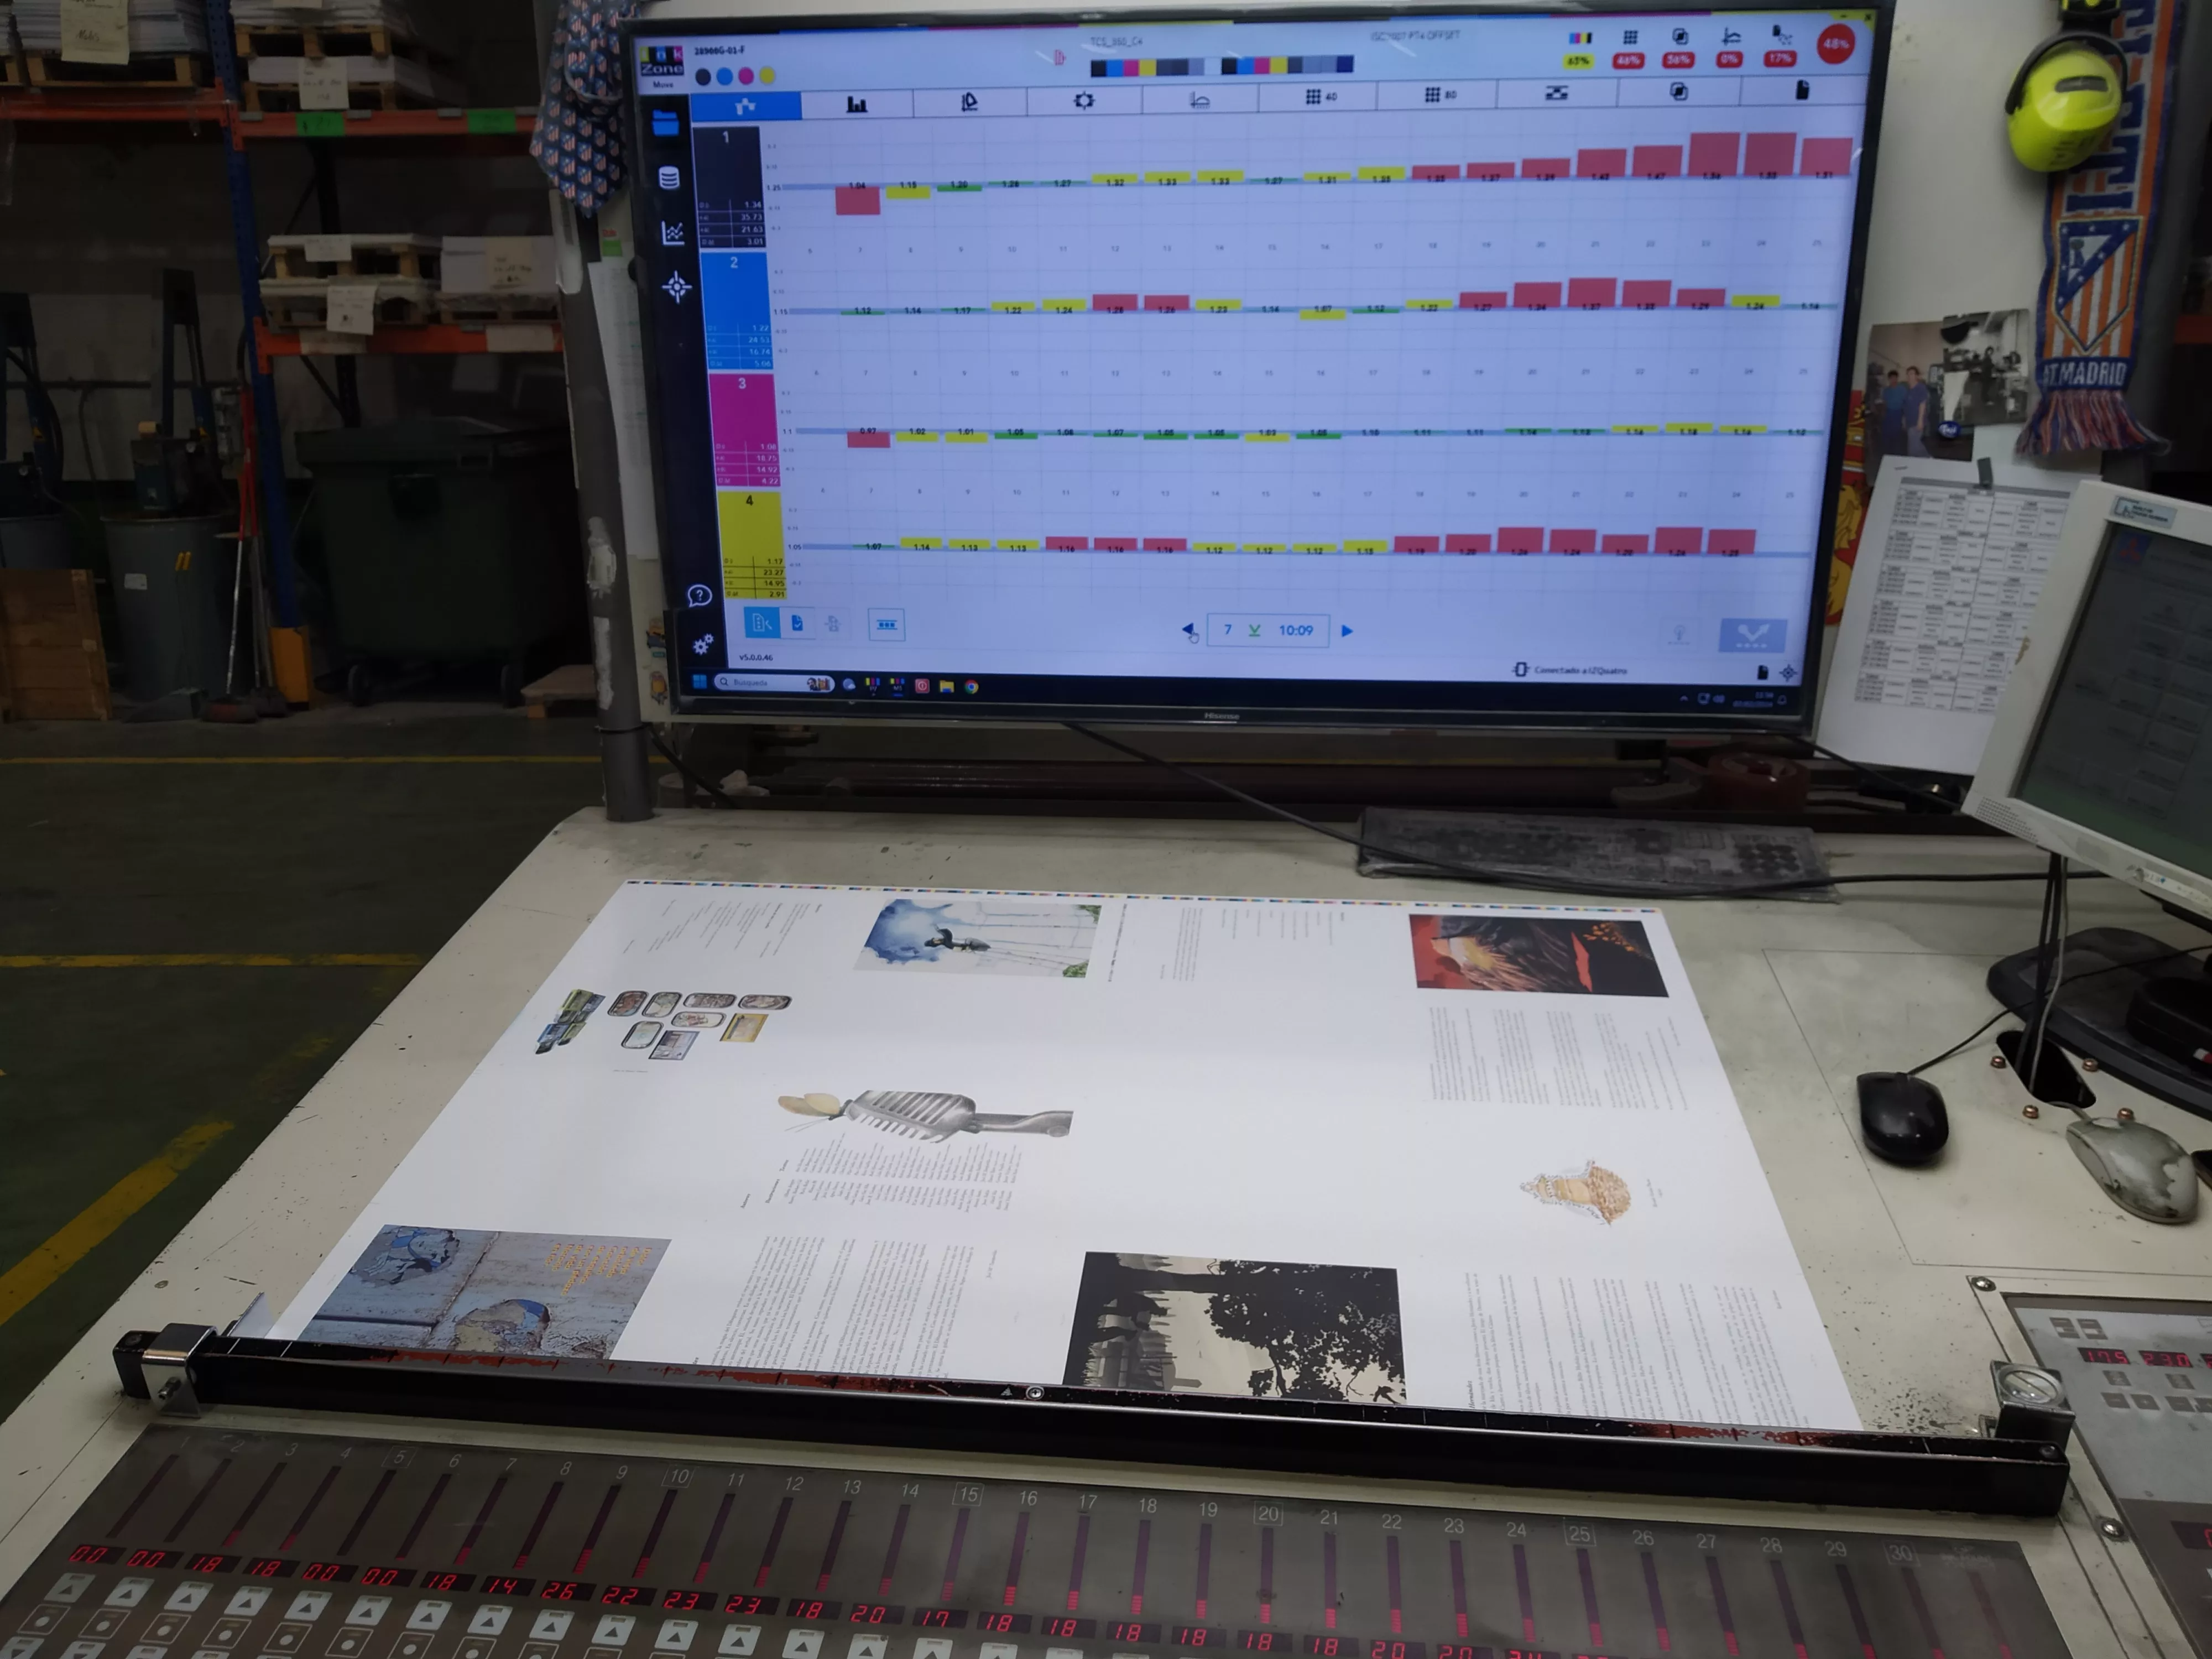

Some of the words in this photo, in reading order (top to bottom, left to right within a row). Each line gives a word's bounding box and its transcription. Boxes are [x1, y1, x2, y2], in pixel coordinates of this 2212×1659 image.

[641, 64, 684, 74] Zone
[723, 131, 729, 143] 1
[731, 257, 738, 269] 2
[738, 378, 746, 389] 3
[745, 495, 754, 506] 4
[1224, 624, 1232, 635] 7
[1280, 625, 1313, 636] 10:09
[1204, 712, 1240, 720] Hisense
[2088, 1351, 2129, 1364] 175
[2143, 1353, 2190, 1367] 230
[285, 1442, 299, 1455] 3
[340, 1446, 352, 1459] 4
[391, 1449, 406, 1464] 5
[448, 1453, 462, 1468] 6
[504, 1457, 518, 1471] 7
[558, 1460, 572, 1477] 8
[614, 1463, 629, 1480] 9
[670, 1467, 690, 1484] 10
[727, 1471, 745, 1488] 11
[784, 1475, 804, 1491] 12
[843, 1479, 862, 1495] 13
[901, 1483, 920, 1498] 14
[959, 1485, 979, 1503] 15
[1018, 1489, 1039, 1507] 16
[1077, 1493, 1098, 1509] 17
[1138, 1497, 1157, 1514] 18
[1198, 1501, 1218, 1518] 19
[1258, 1504, 1280, 1522] 20
[1319, 1509, 1339, 1526] 21
[1381, 1512, 1403, 1530] 22
[1443, 1517, 1465, 1533] 23
[1506, 1521, 1527, 1538] 24
[1569, 1524, 1590, 1542] 25
[1632, 1528, 1655, 1546] 26
[1695, 1532, 1718, 1548] 27
[1759, 1536, 1783, 1553] 28
[1824, 1540, 1847, 1557] 29
[69, 1546, 107, 1563] 00
[127, 1550, 165, 1568] 00
[1890, 1545, 1913, 1562] 30
[193, 1556, 222, 1573] 18
[252, 1561, 281, 1577] 18
[302, 1563, 340, 1582] 00
[361, 1568, 398, 1586] 00
[429, 1574, 457, 1591] 18
[489, 1579, 518, 1594] 14
[541, 1582, 577, 1600] 26
[602, 1587, 638, 1605] 22
[663, 1592, 700, 1610] 23
[725, 1595, 761, 1615] 23
[796, 1601, 823, 1619] 18
[851, 1605, 885, 1624] 20
[922, 1610, 950, 1627] 17
[986, 1614, 1013, 1632] 18
[1051, 1619, 1077, 1637] 18
[1116, 1624, 1141, 1641] 18
[1181, 1629, 1206, 1646] 18
[1247, 1633, 1272, 1651] 18
[1313, 1638, 1338, 1656] 18
[1371, 1641, 1405, 1659] 20
